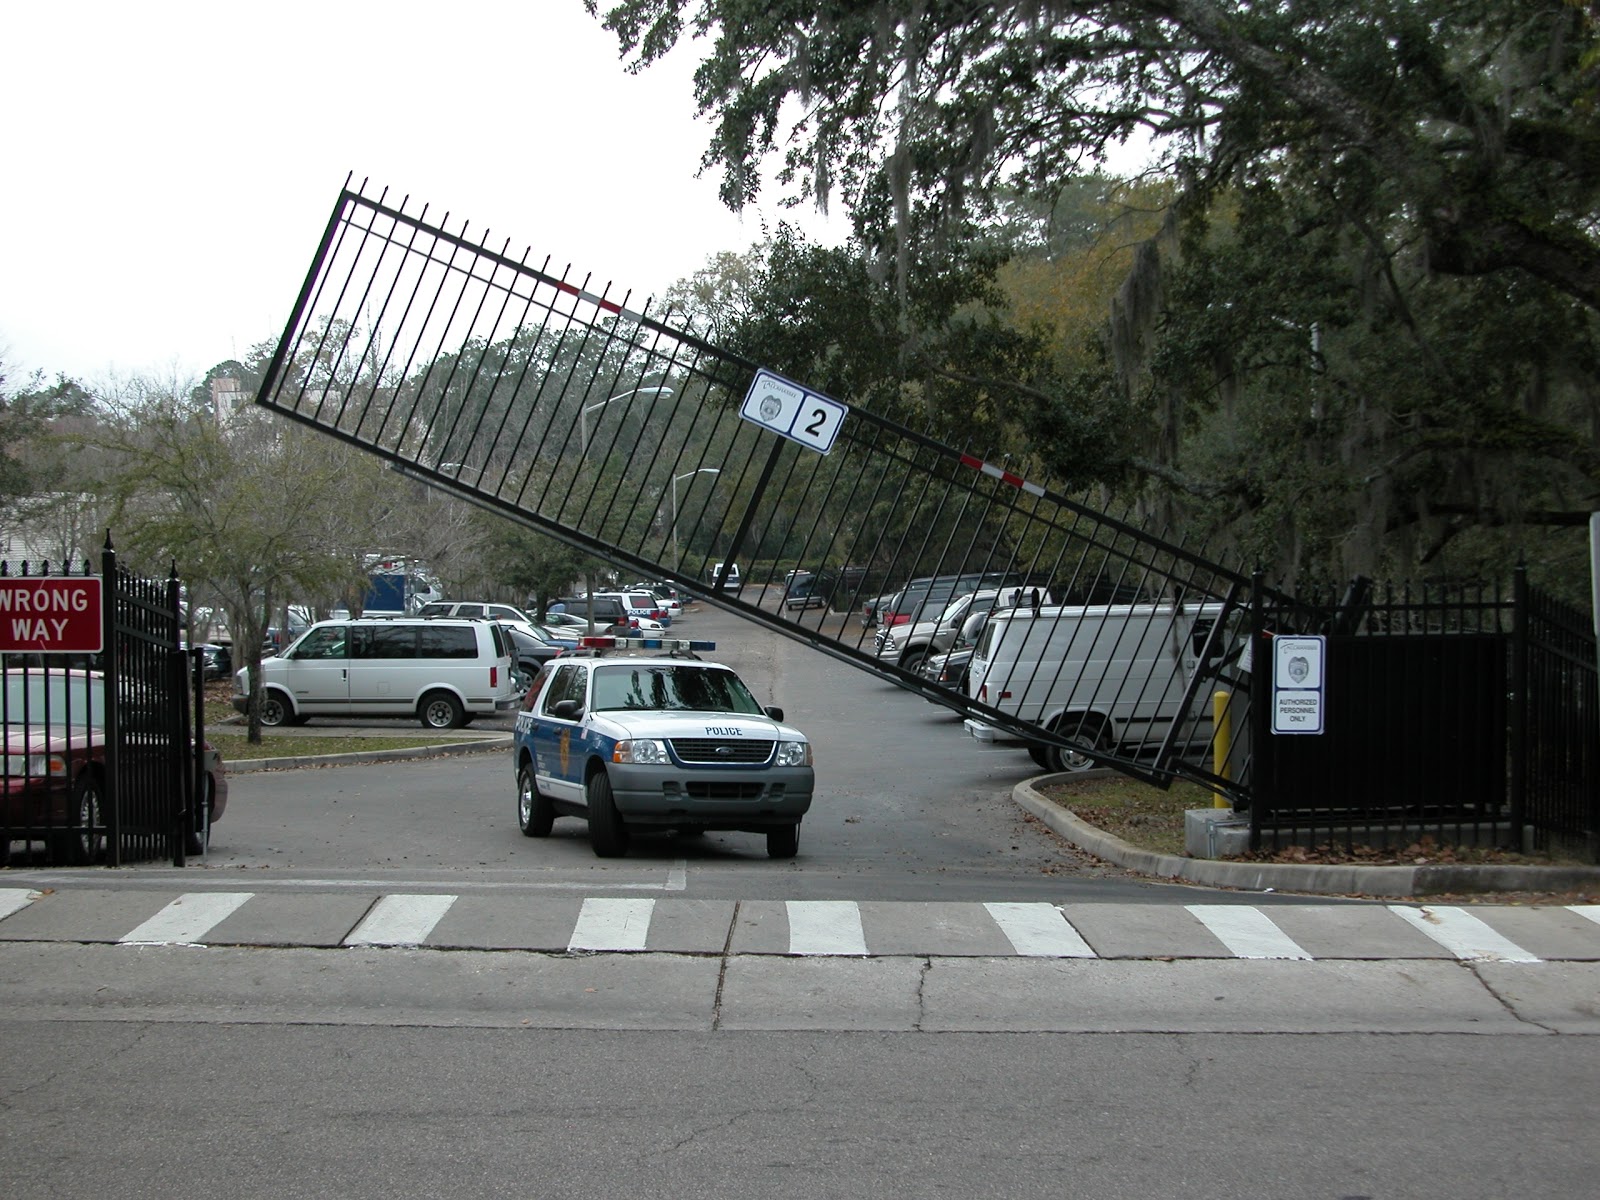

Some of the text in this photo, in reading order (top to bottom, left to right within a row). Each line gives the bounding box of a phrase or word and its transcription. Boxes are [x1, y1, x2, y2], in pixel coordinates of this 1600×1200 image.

[804, 408, 828, 438] 2
[0, 589, 88, 612] WRONG
[12, 618, 69, 641] WAY
[705, 726, 743, 736] POLICE
